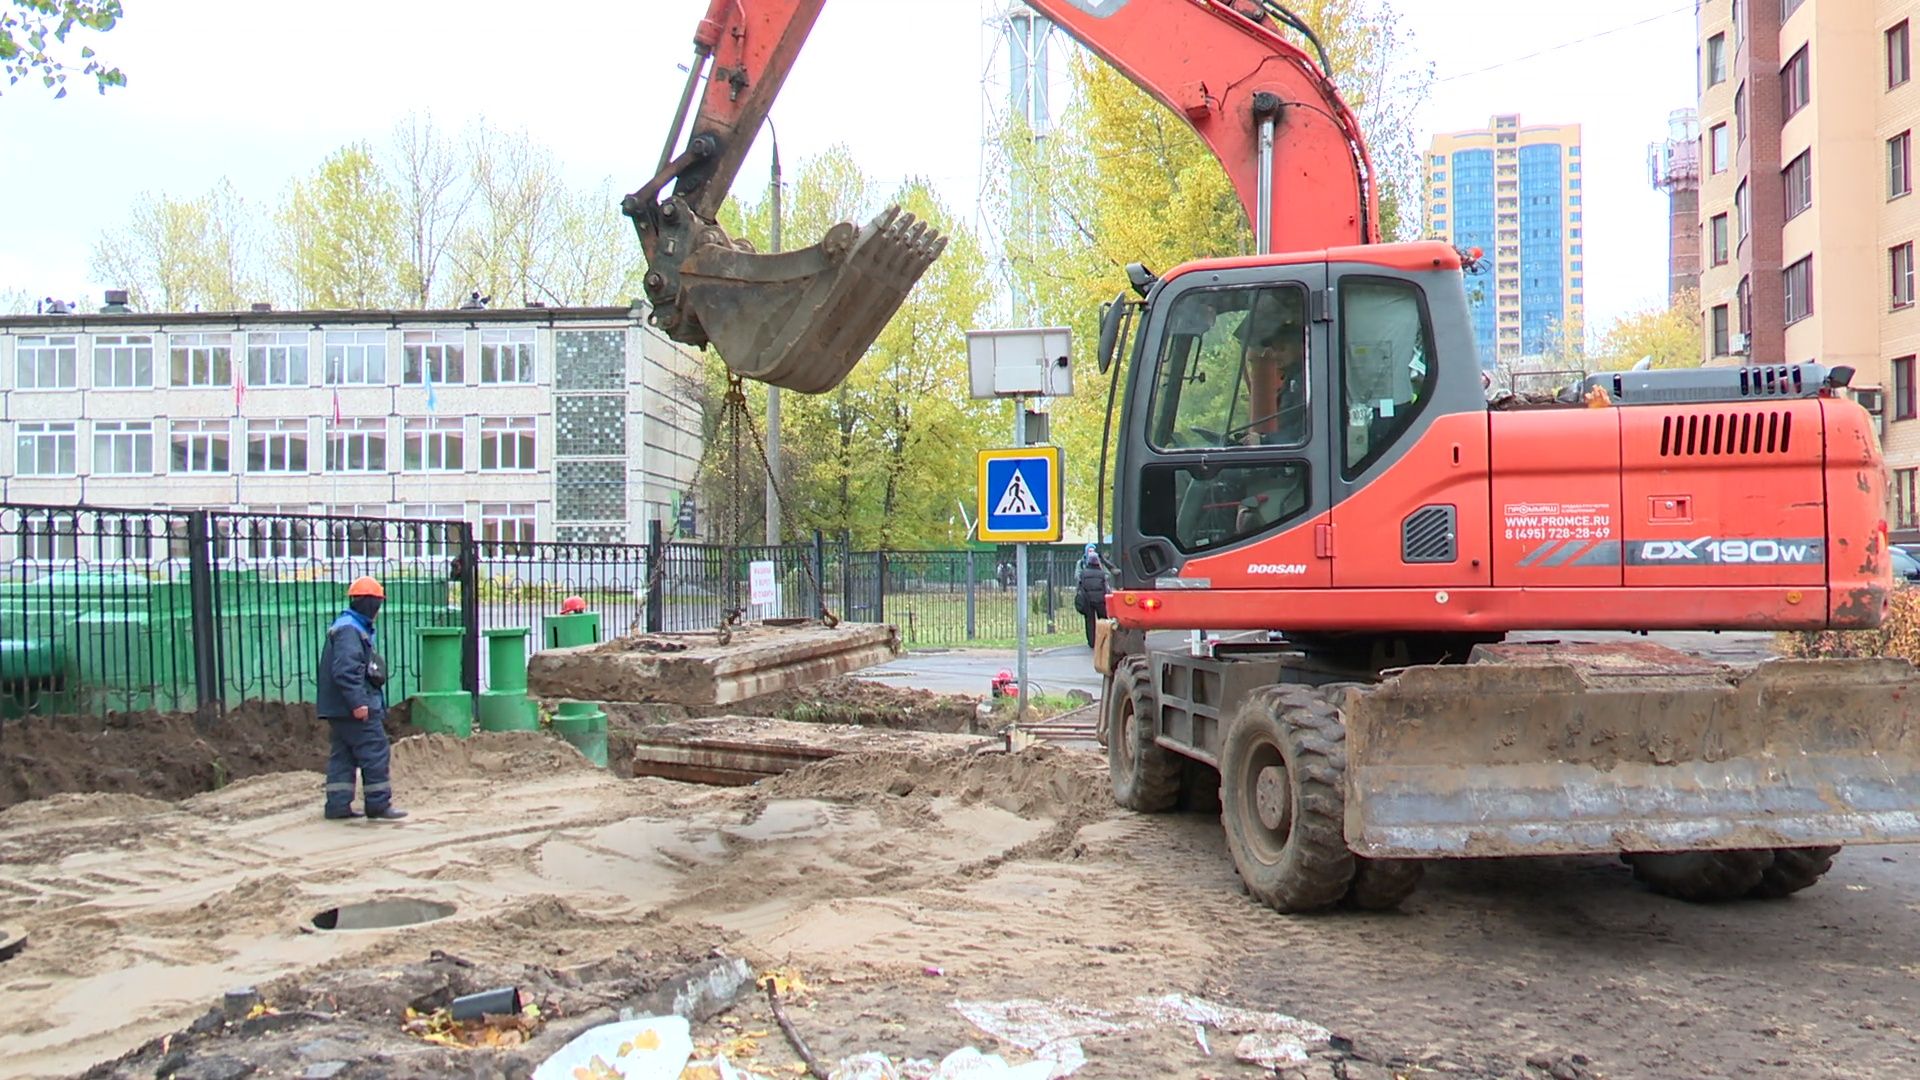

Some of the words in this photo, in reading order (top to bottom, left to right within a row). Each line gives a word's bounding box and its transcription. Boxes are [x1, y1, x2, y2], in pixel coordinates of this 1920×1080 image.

[1505, 516, 1609, 527] WWW.PROMCE.RU
[1505, 528, 1513, 539] 8
[1515, 528, 1545, 540] (495)
[1548, 528, 1610, 539] 728-28-69
[1247, 564, 1307, 574] DOOSAN
